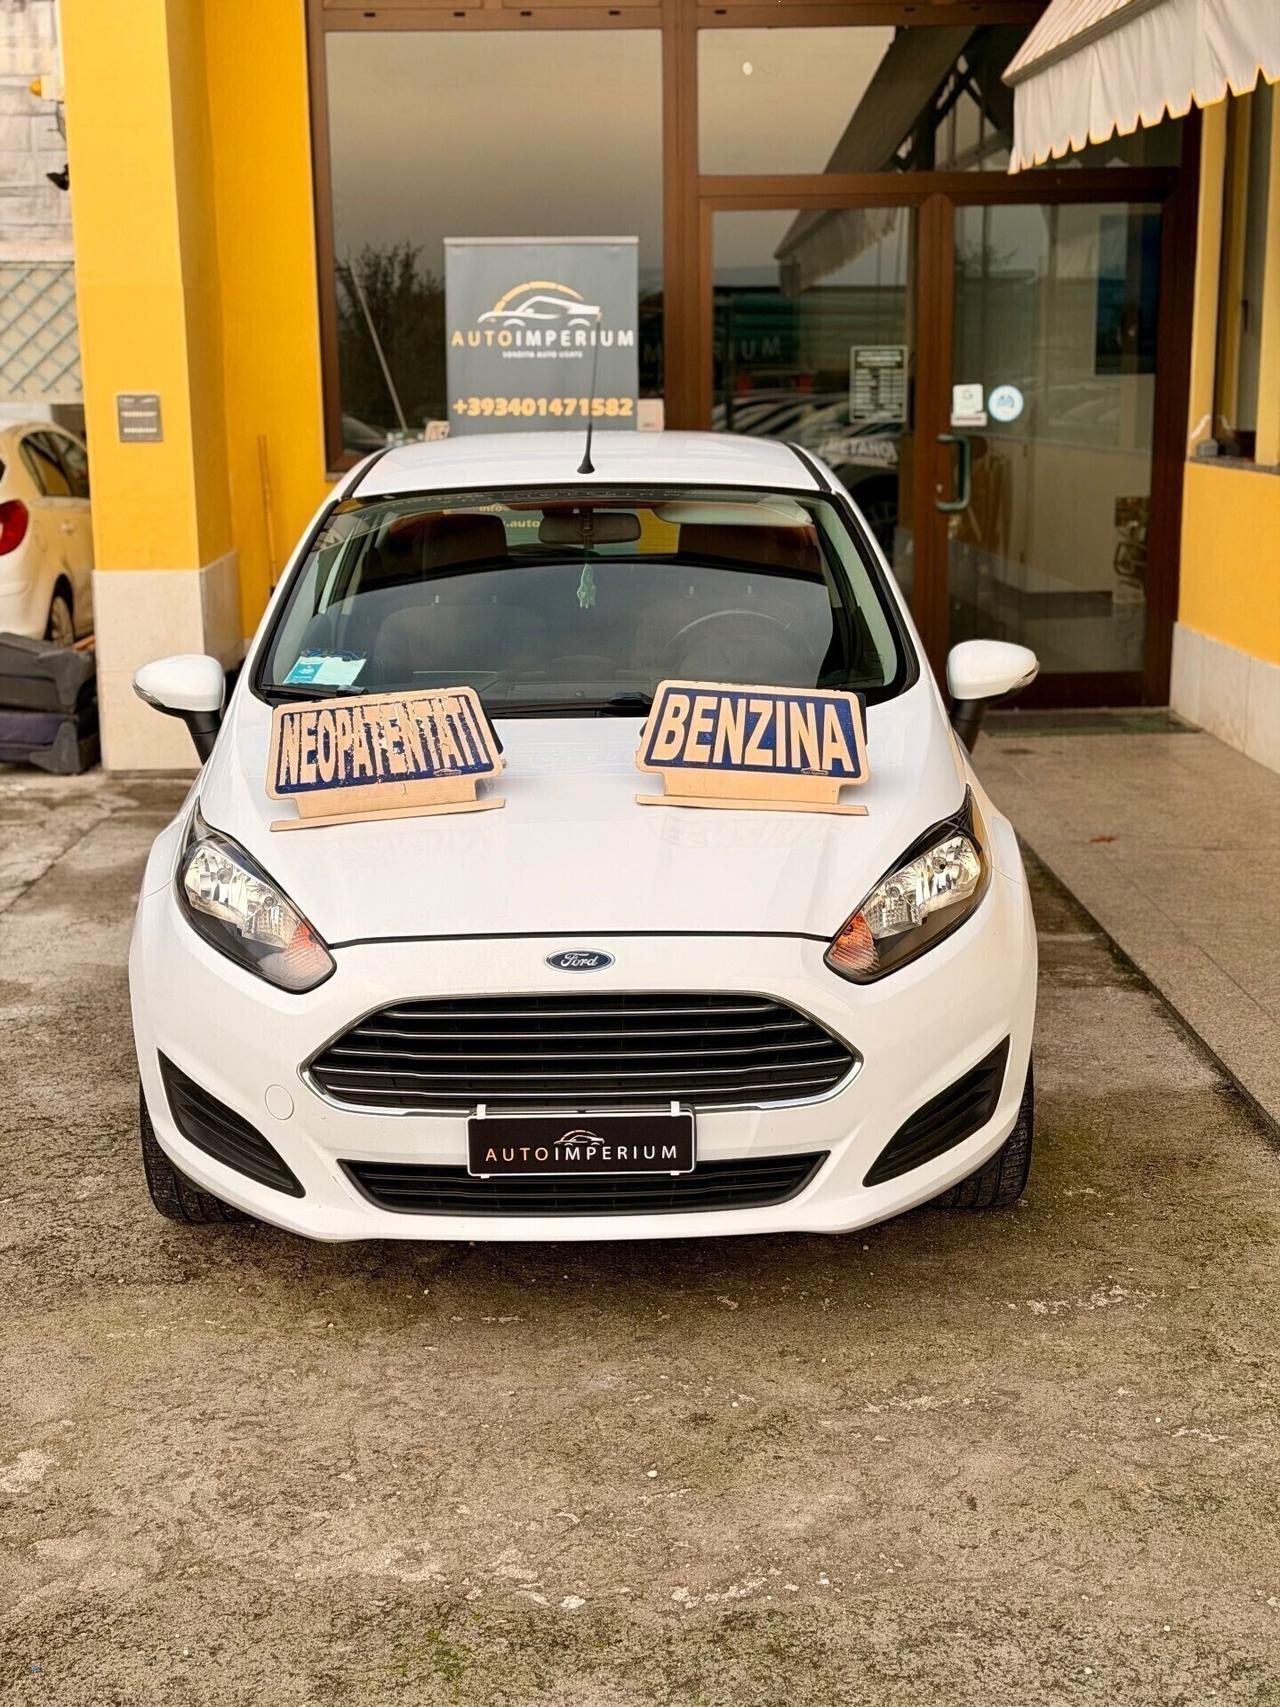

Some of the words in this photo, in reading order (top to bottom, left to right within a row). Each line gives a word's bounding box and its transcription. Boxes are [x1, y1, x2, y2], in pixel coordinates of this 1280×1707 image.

[451, 329, 635, 347] AUTOIMPERIUM
[453, 398, 633, 417] +393401471582
[278, 696, 489, 786] NEOPATENTATI
[650, 693, 855, 772] BENZINA
[560, 952, 599, 967] Ford
[485, 1145, 678, 1162] AUTOIMPERIUM
